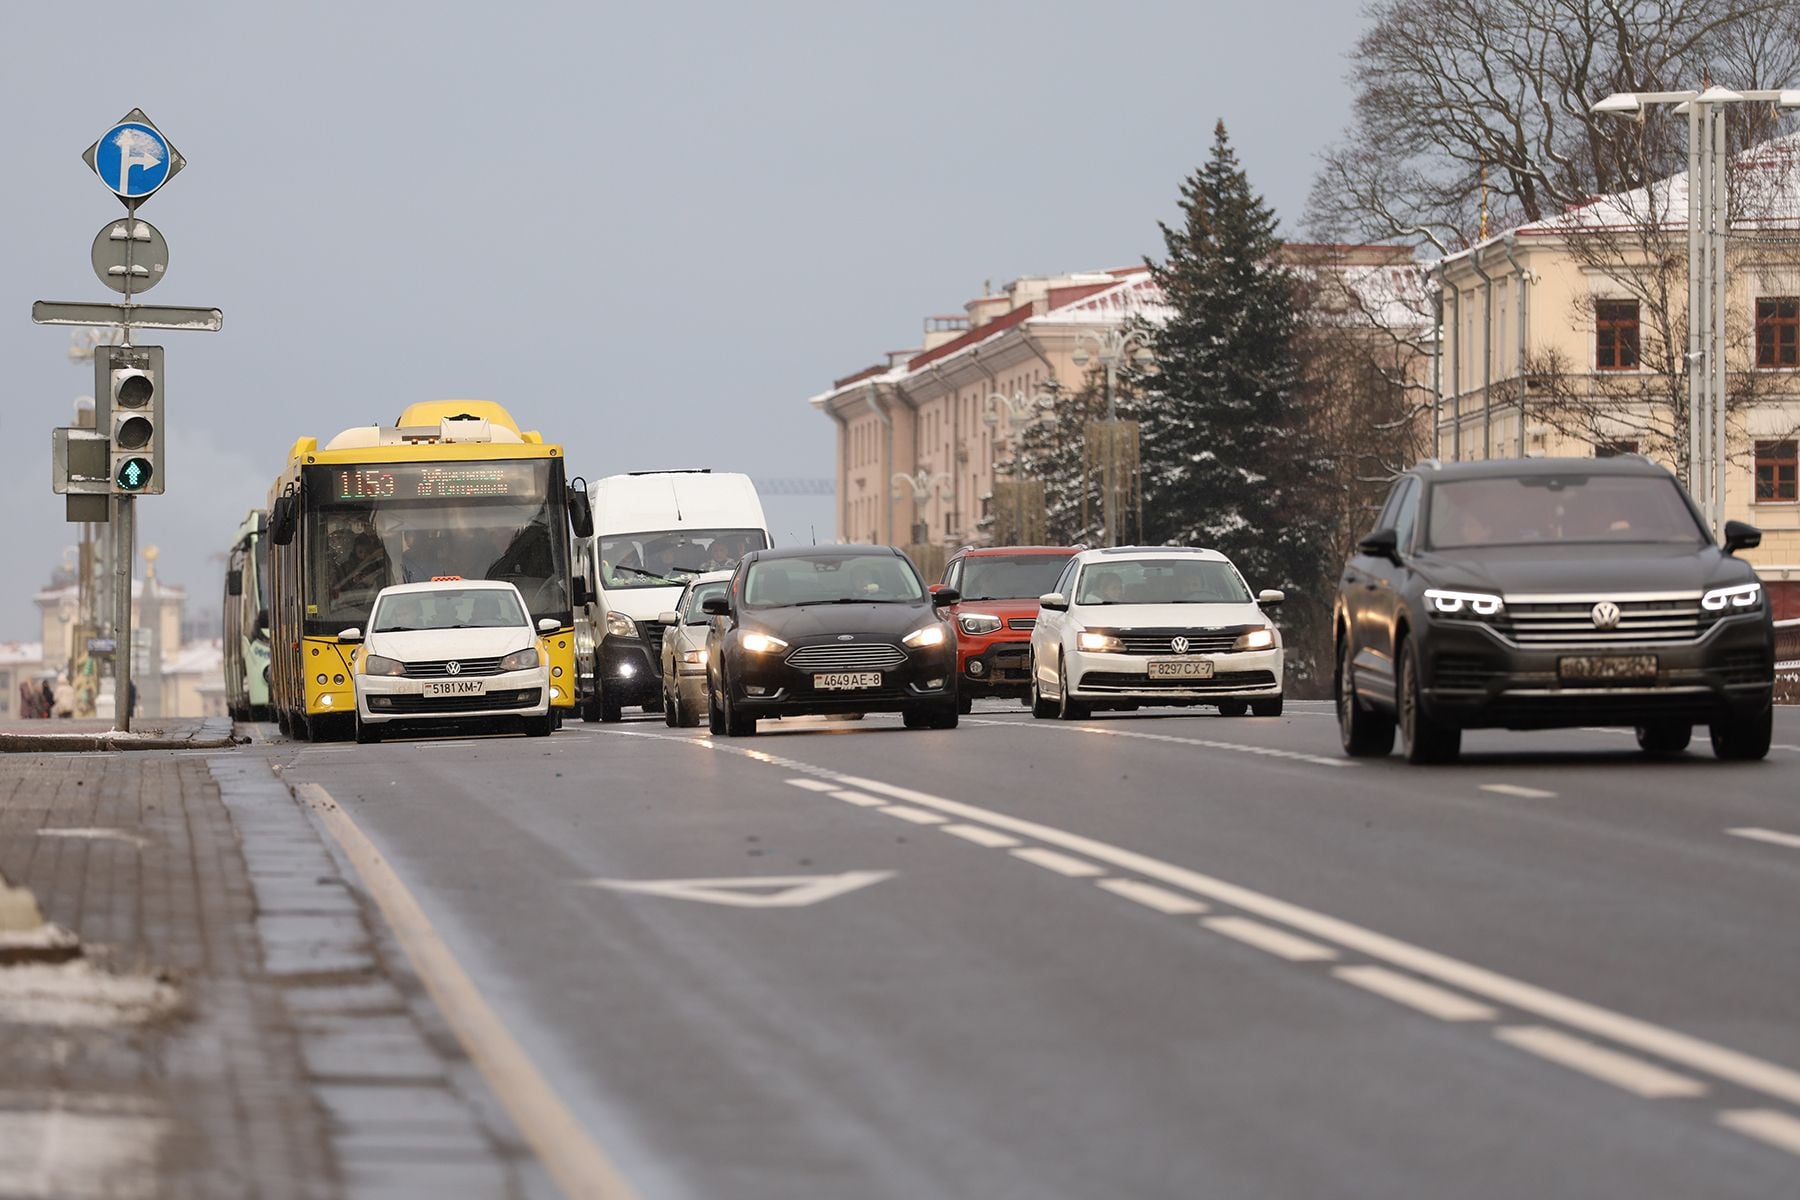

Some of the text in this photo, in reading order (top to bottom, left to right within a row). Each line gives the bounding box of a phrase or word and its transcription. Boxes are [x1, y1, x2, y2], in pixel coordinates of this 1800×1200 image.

[1158, 663, 1183, 675] 8297
[824, 674, 850, 686] 4649
[433, 683, 456, 694] 5181
